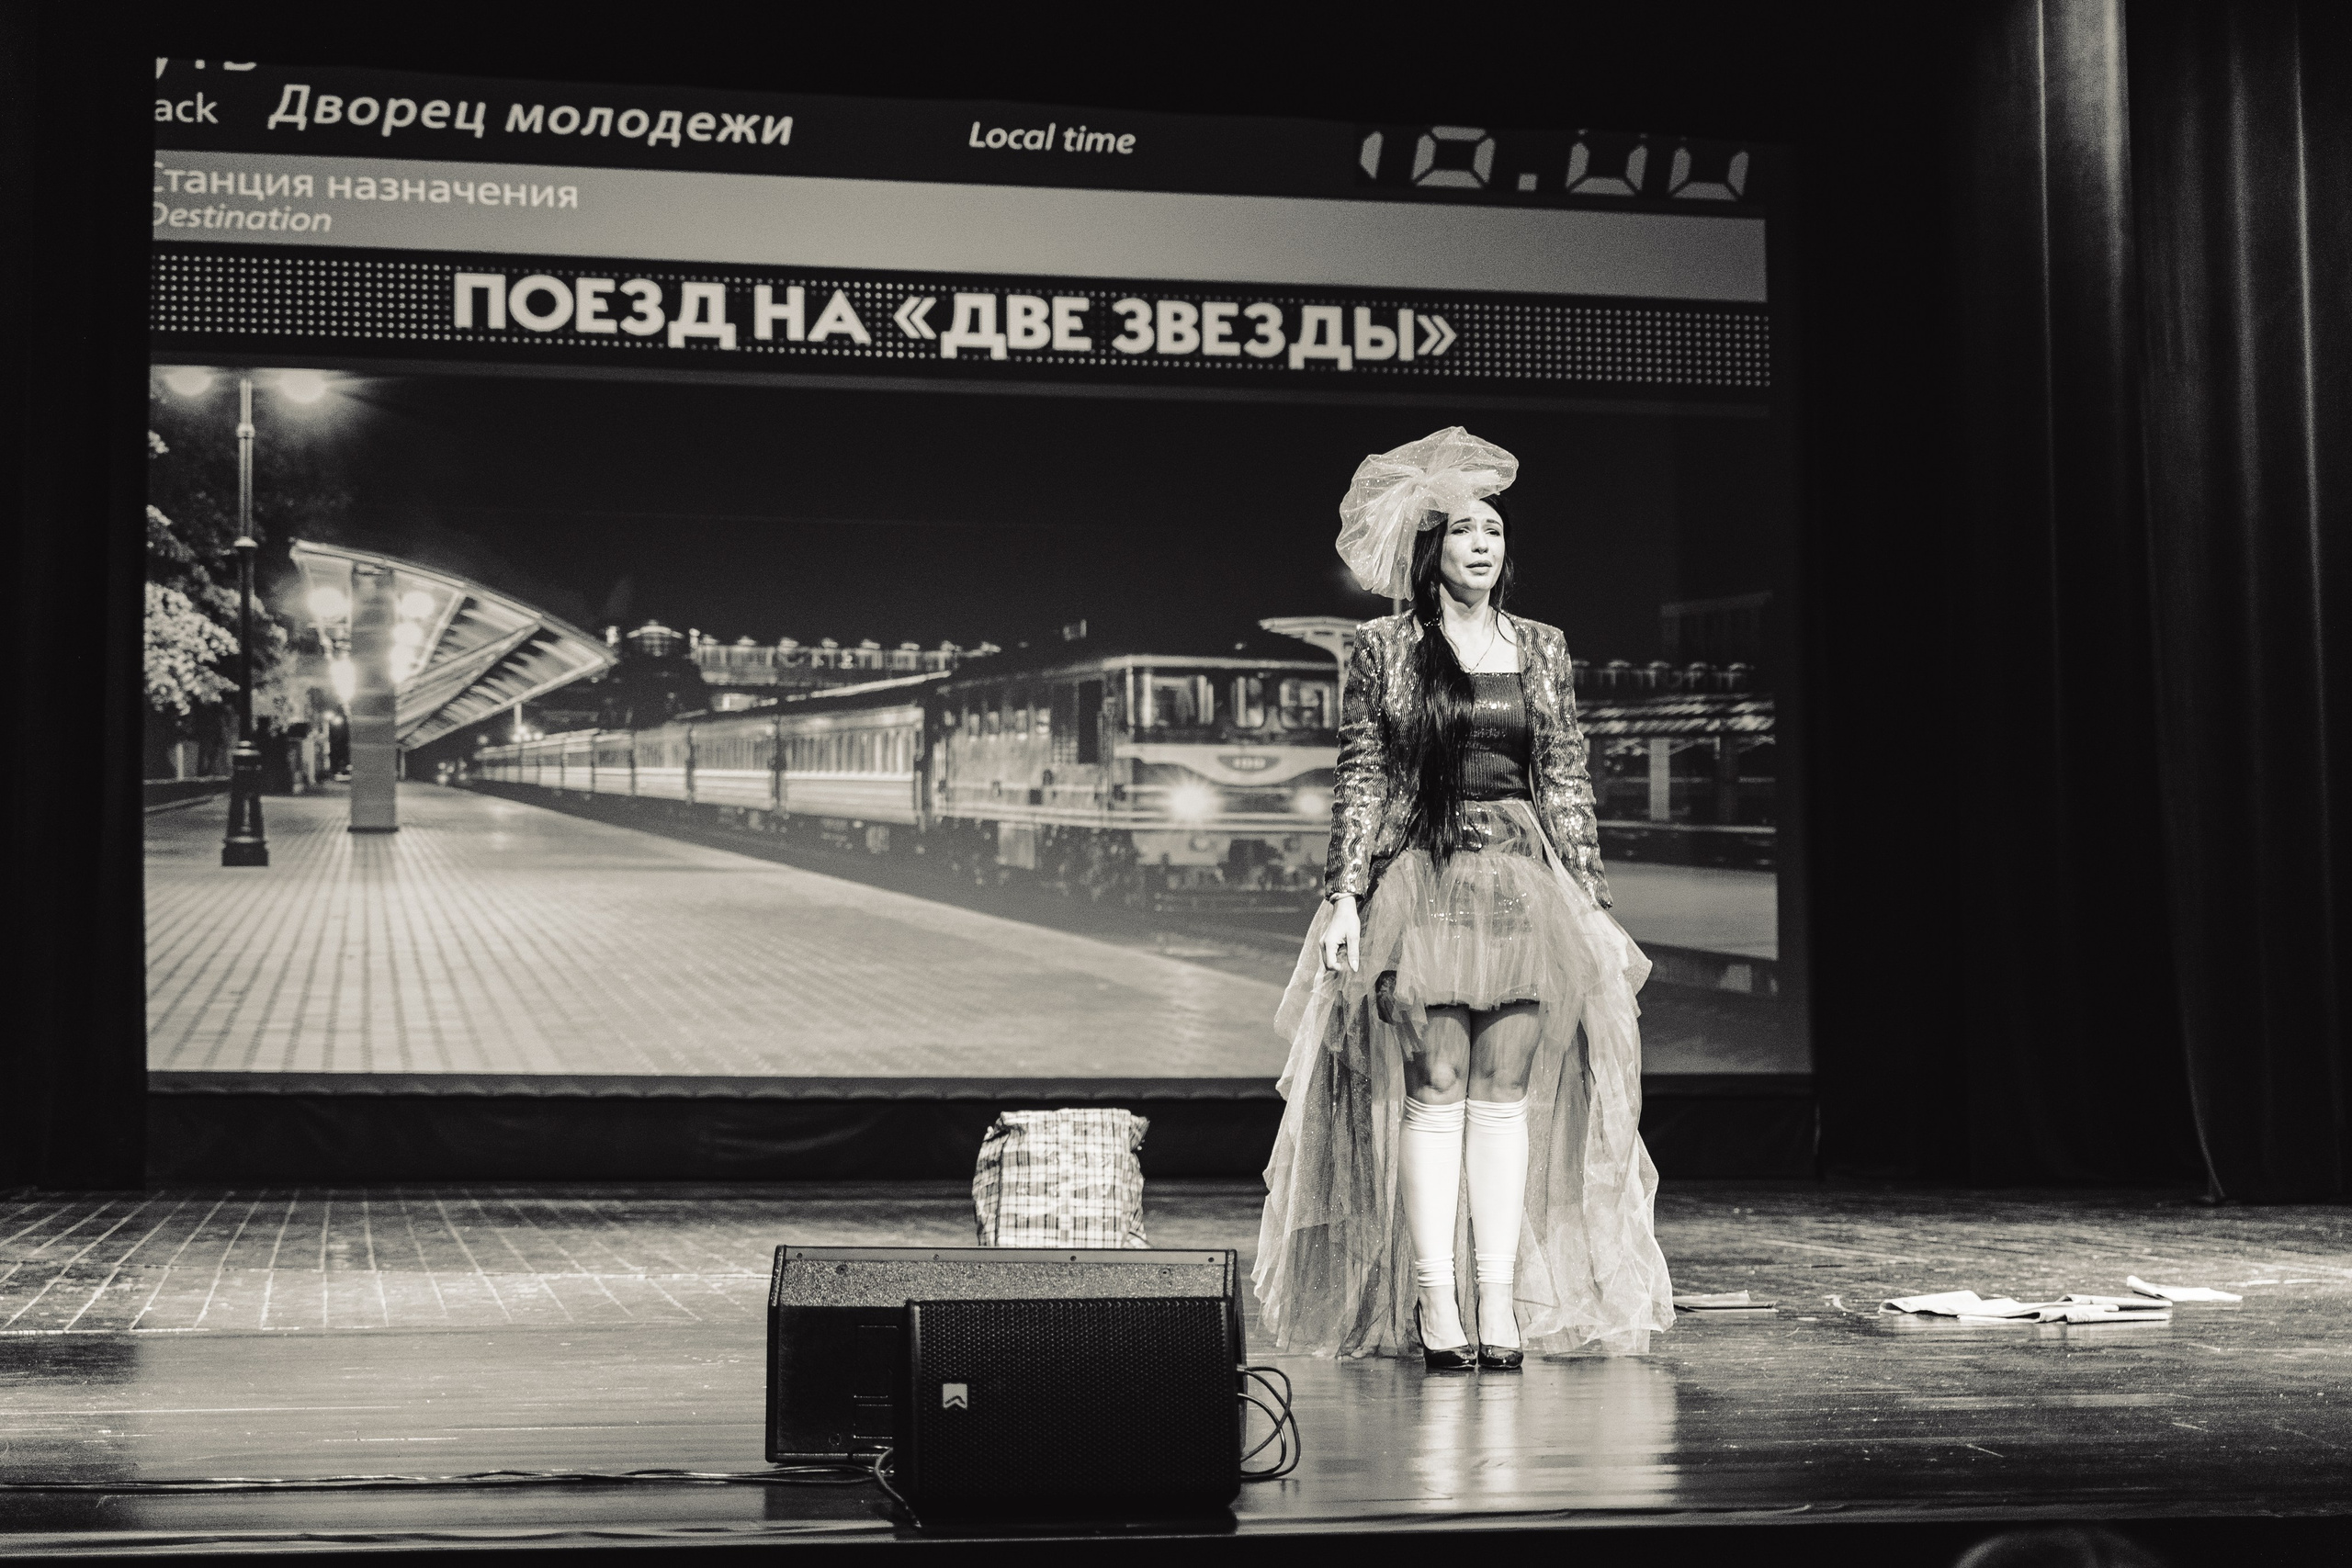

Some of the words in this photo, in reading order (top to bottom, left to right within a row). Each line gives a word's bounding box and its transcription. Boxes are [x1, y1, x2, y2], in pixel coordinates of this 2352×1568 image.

[268, 84, 486, 138] Дворец
[505, 104, 794, 148] молодежи
[969, 121, 1057, 152] Local
[1063, 127, 1136, 155] time
[328, 175, 579, 209] назначения
[454, 272, 736, 350] ПОЕЗД
[754, 284, 872, 344] НА
[893, 292, 1092, 360] «ДВЕ
[1112, 297, 1457, 370] ЗВЕЗДЫ»
